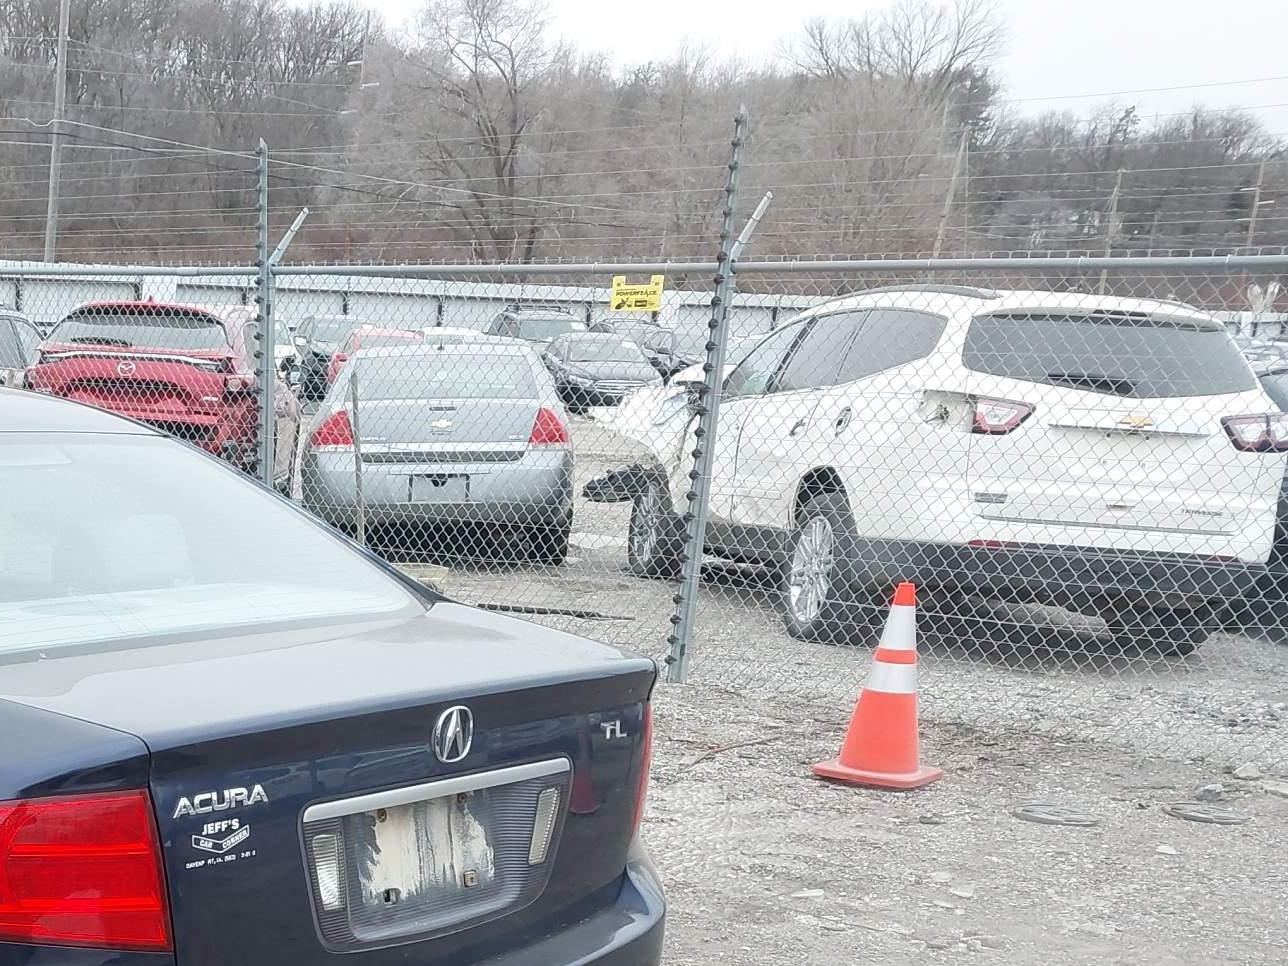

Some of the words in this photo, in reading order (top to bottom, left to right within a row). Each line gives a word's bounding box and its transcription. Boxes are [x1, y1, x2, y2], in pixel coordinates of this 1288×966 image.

[600, 719, 628, 740] TL
[172, 783, 269, 819] ACURA
[201, 818, 240, 836] JEFF'S
[199, 840, 213, 849] CAR
[222, 829, 248, 849] CORNER
